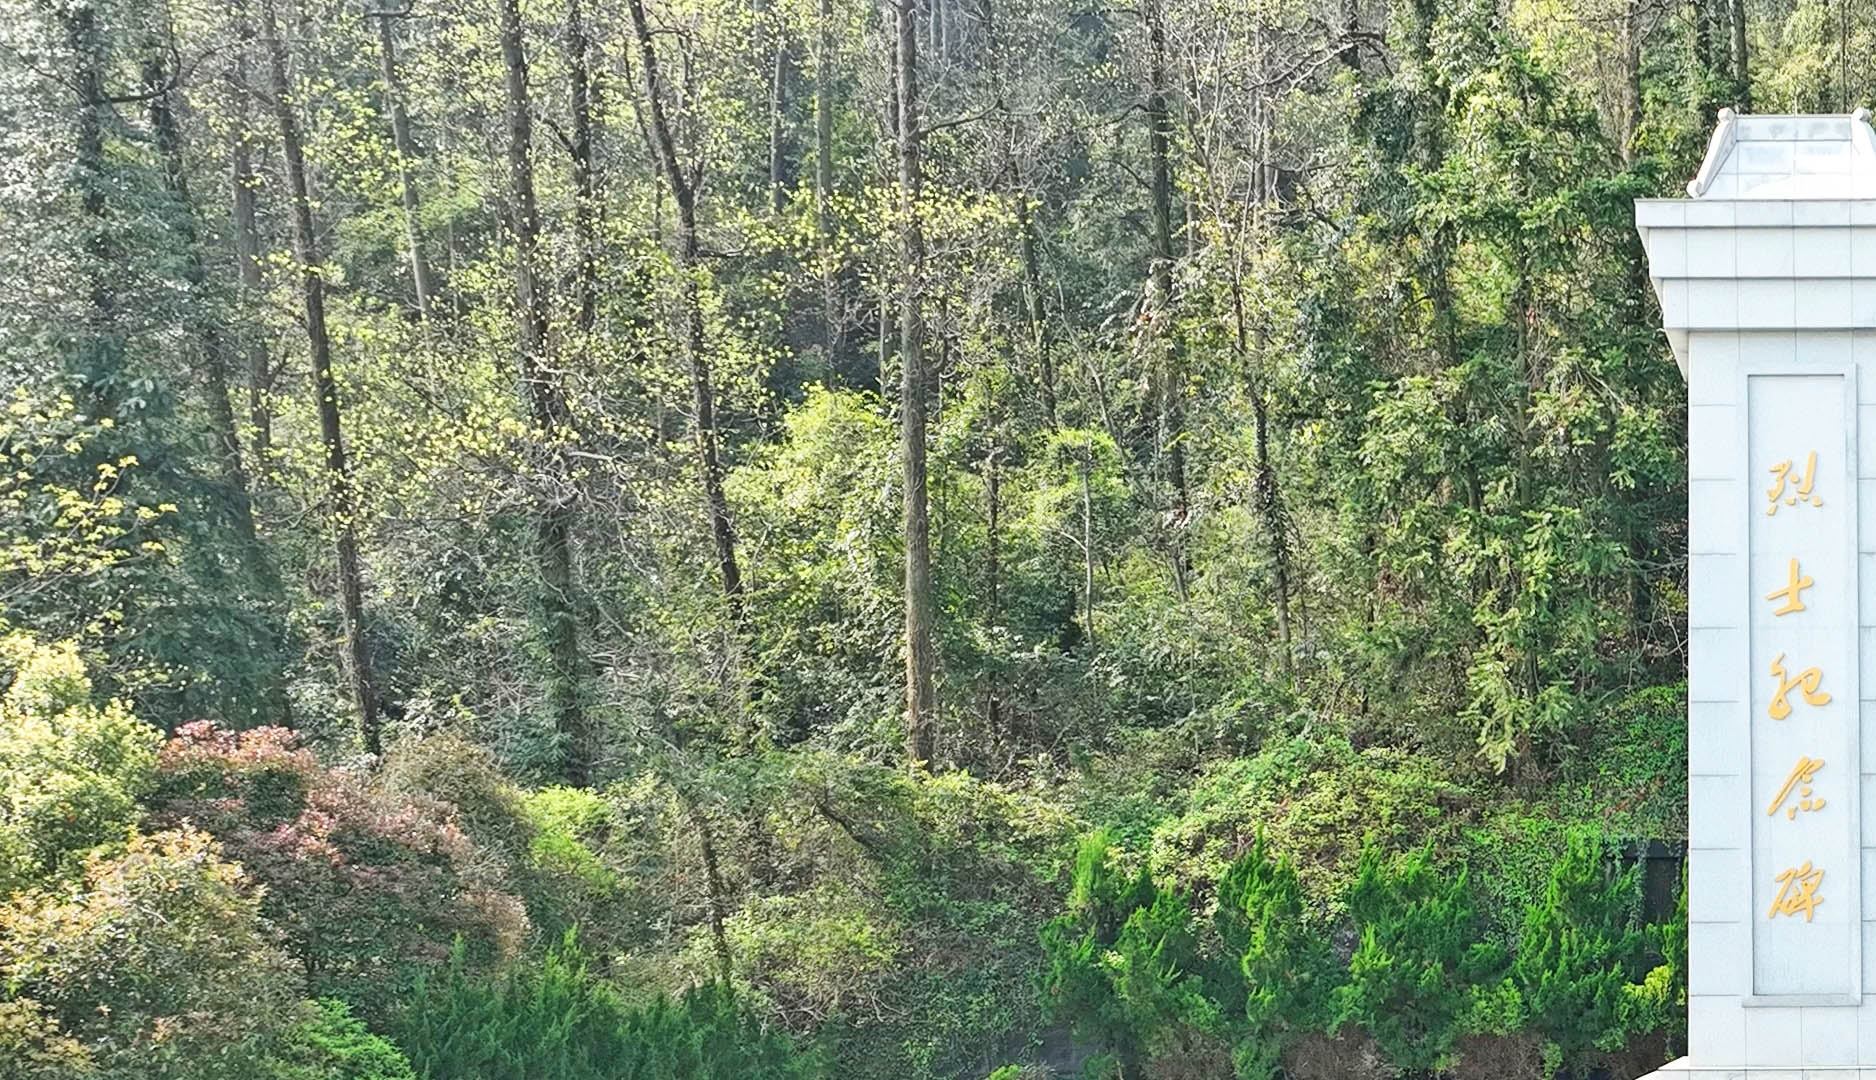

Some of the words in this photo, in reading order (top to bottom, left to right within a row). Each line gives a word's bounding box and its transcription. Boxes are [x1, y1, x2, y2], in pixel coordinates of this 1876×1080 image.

[1766, 450, 1832, 922] 烈士纪念碑
